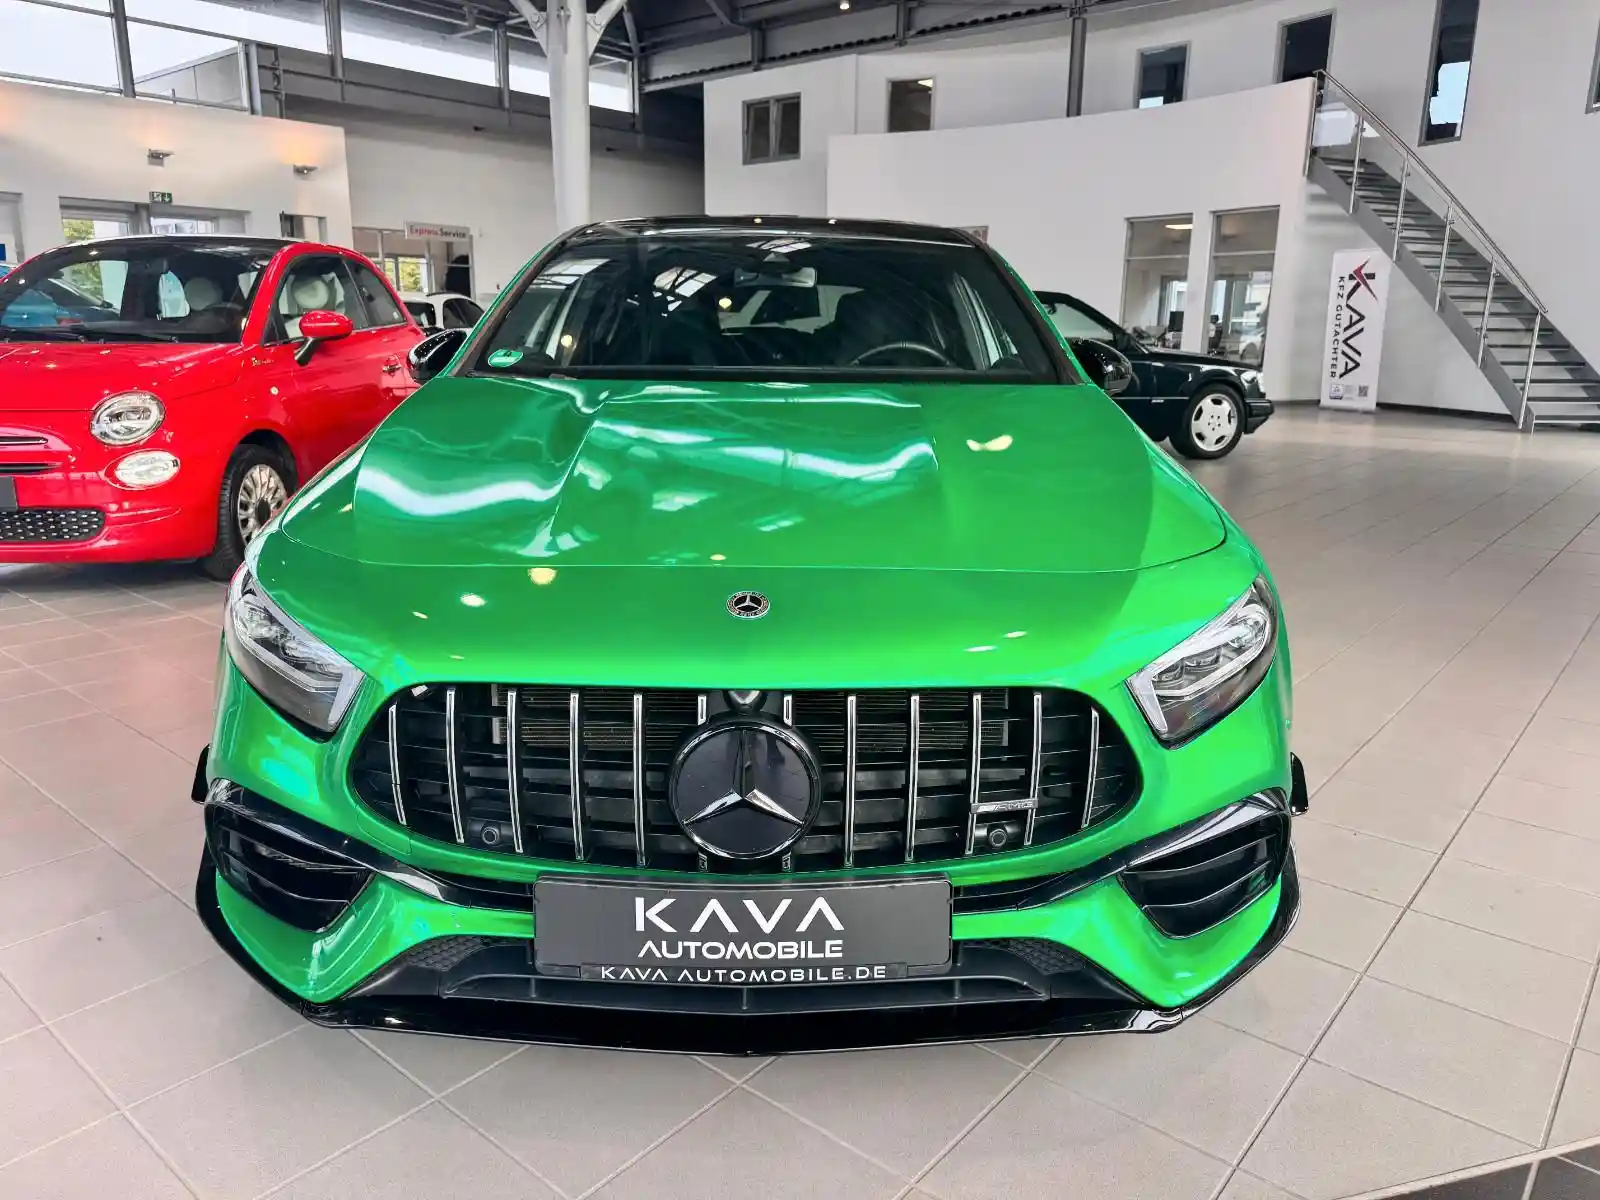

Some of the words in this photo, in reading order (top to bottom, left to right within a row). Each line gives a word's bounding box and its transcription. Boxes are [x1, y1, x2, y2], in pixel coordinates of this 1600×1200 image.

[1336, 276, 1346, 300] KFZ
[1338, 258, 1378, 380] KAVA
[1330, 304, 1343, 378] GUTACHTER
[635, 897, 845, 934] KAVA
[637, 940, 844, 960] AUTOMOBILE
[600, 965, 669, 981] KAVA
[677, 965, 887, 982] AUTOMOBILE.DE
